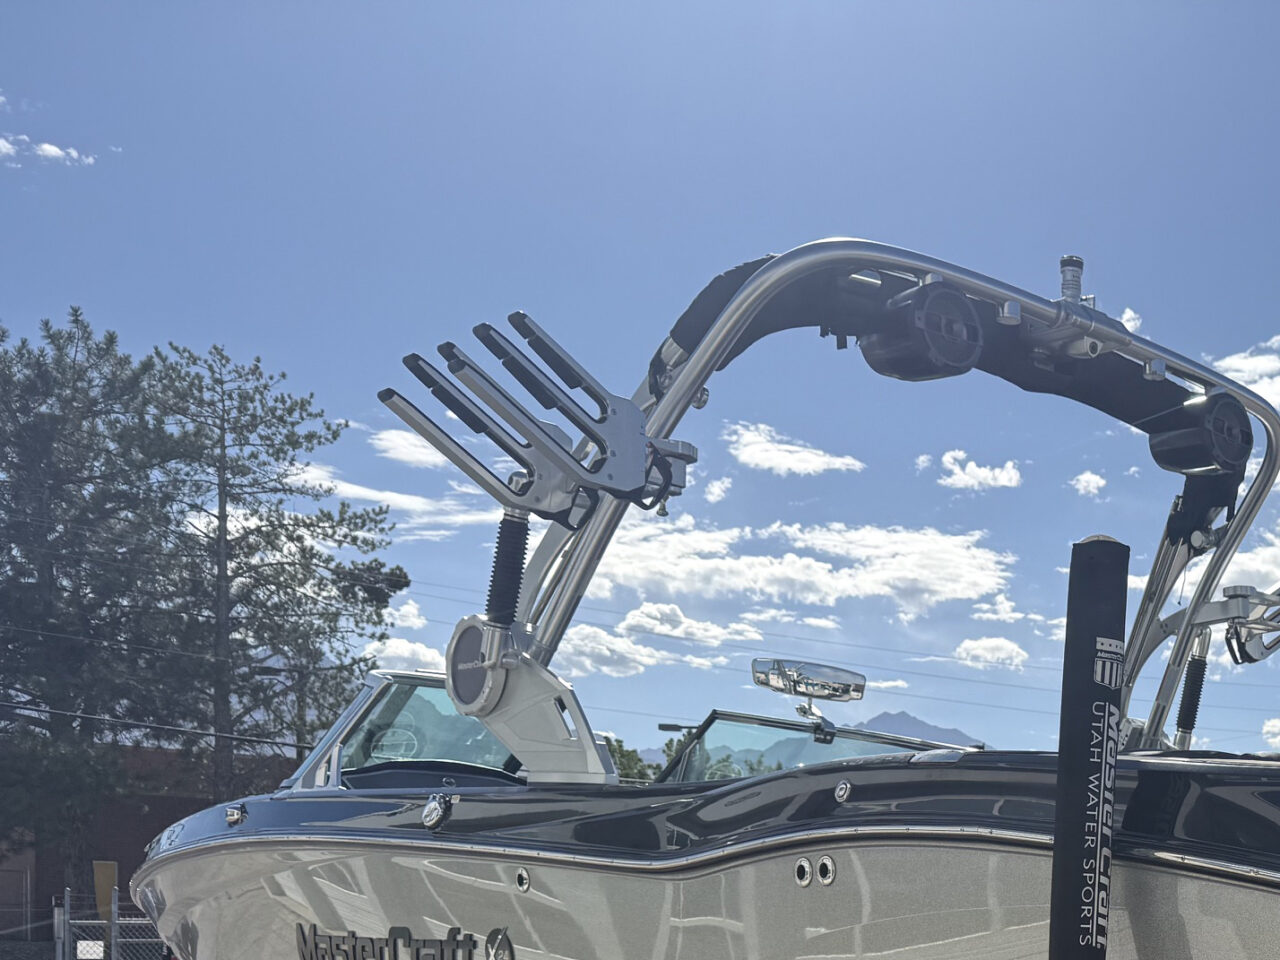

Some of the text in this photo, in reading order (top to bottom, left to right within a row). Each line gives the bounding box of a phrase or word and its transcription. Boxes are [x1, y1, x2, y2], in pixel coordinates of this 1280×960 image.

[1079, 701, 1105, 946] UTAH WATER SPORTS
